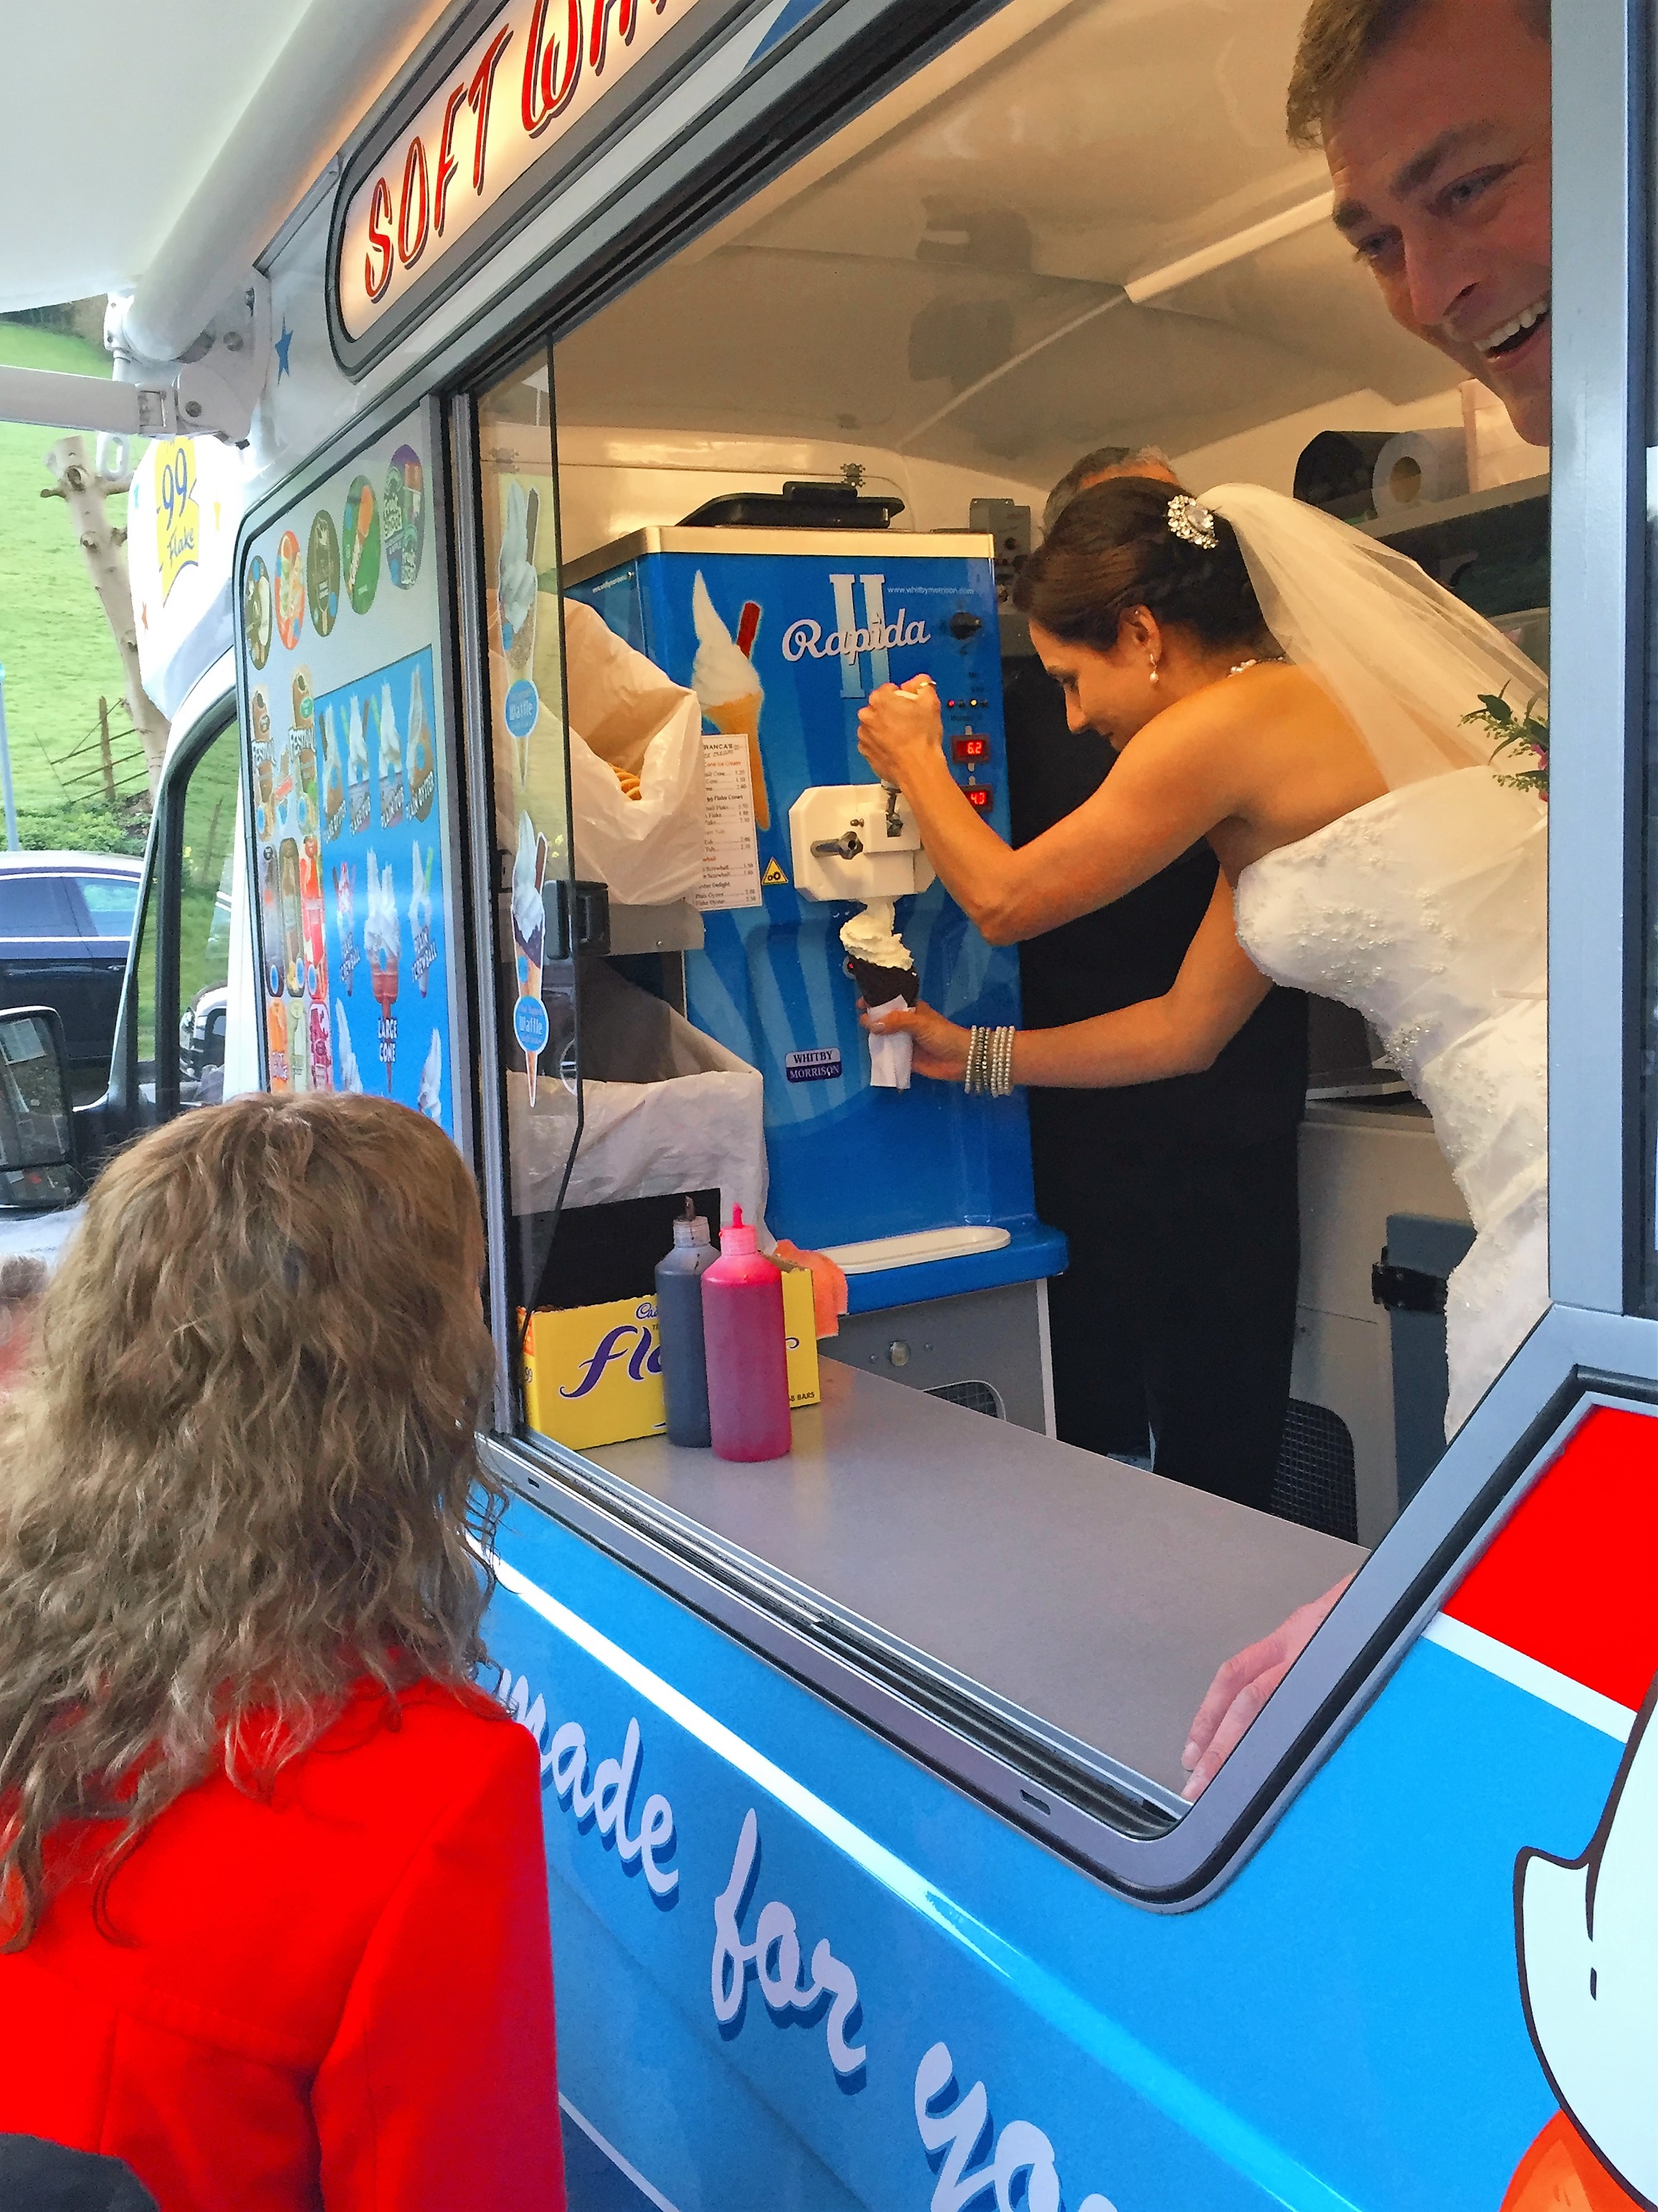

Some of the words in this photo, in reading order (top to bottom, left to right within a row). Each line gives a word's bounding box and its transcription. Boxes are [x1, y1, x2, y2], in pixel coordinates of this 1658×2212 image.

[365, 24, 513, 303] SOFT
[162, 447, 188, 531] 99
[166, 526, 195, 569] Flake
[782, 608, 931, 665] Rapida
[509, 700, 533, 721] Waffle
[378, 1018, 398, 1040] LARGE
[519, 1015, 543, 1035] Waffle
[379, 1042, 396, 1063] CONE
[793, 1050, 833, 1064] WHITBY
[789, 1065, 839, 1079] MORRISON
[797, 1391, 815, 1400] BARS
[914, 2041, 1118, 2212] yo
